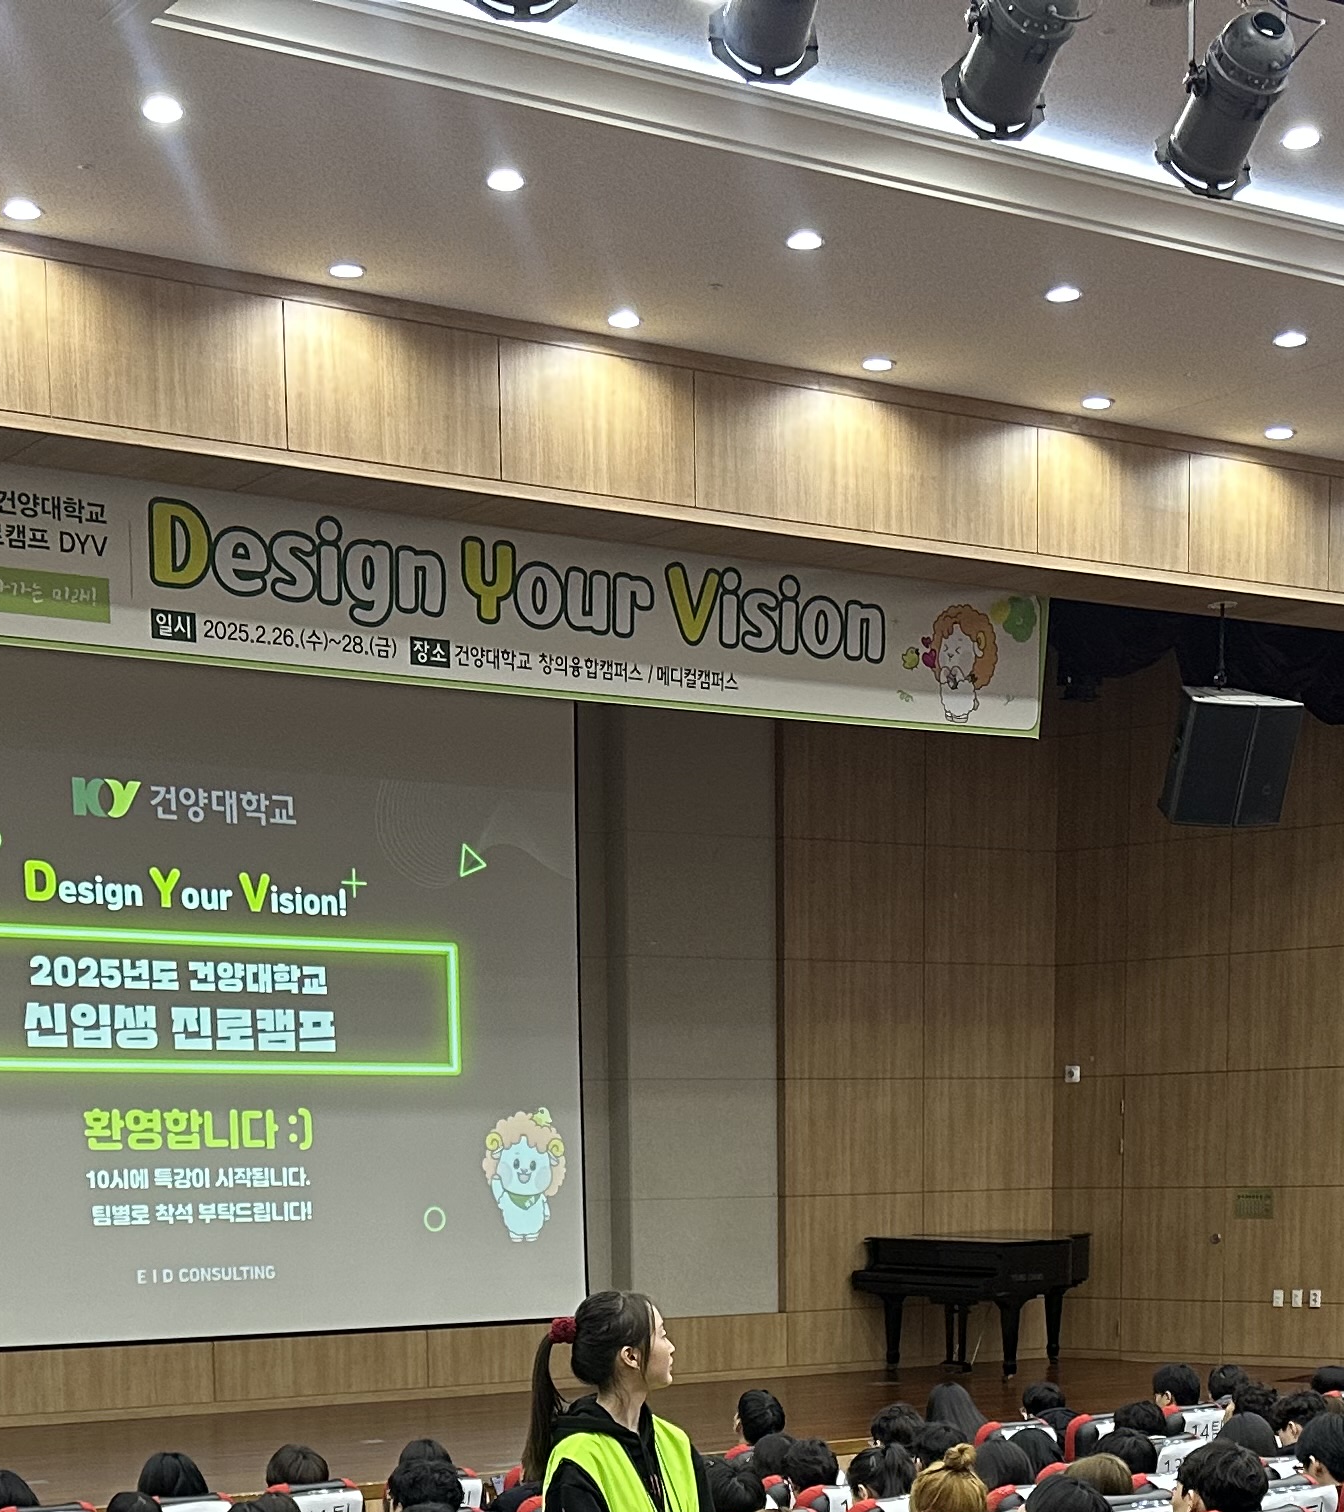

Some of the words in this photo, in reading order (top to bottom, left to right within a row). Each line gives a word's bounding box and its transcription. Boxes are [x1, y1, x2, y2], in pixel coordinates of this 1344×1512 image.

[59, 530, 108, 557] DYV
[147, 496, 447, 628] Design
[460, 535, 655, 641] Your
[664, 561, 887, 665] Vision
[155, 612, 192, 641] 일시
[413, 638, 449, 665] 장소
[454, 644, 533, 672] 건양대학교
[538, 652, 645, 683] 창의융합캠퍼스
[656, 665, 740, 693] 메디컬캠퍼스
[70, 776, 142, 819] KY
[149, 785, 298, 827] 건양대학교
[23, 858, 144, 912] Design
[148, 866, 234, 912] Your
[238, 871, 348, 917] Vision!
[28, 954, 180, 992] 2025년도
[187, 960, 328, 995] 건양대학교
[23, 1001, 159, 1050] 신입생
[170, 1006, 337, 1053] 진로캠프
[83, 1107, 280, 1151] 환영합니다
[85, 1167, 150, 1190] 10시에
[153, 1167, 211, 1189] 특강이
[214, 1166, 311, 1188] 시작됩니다.
[91, 1203, 151, 1227] 팀별로
[155, 1202, 194, 1225] 착석
[198, 1200, 313, 1224] 부탁드립니다!
[178, 1264, 276, 1284] CONSULTING
